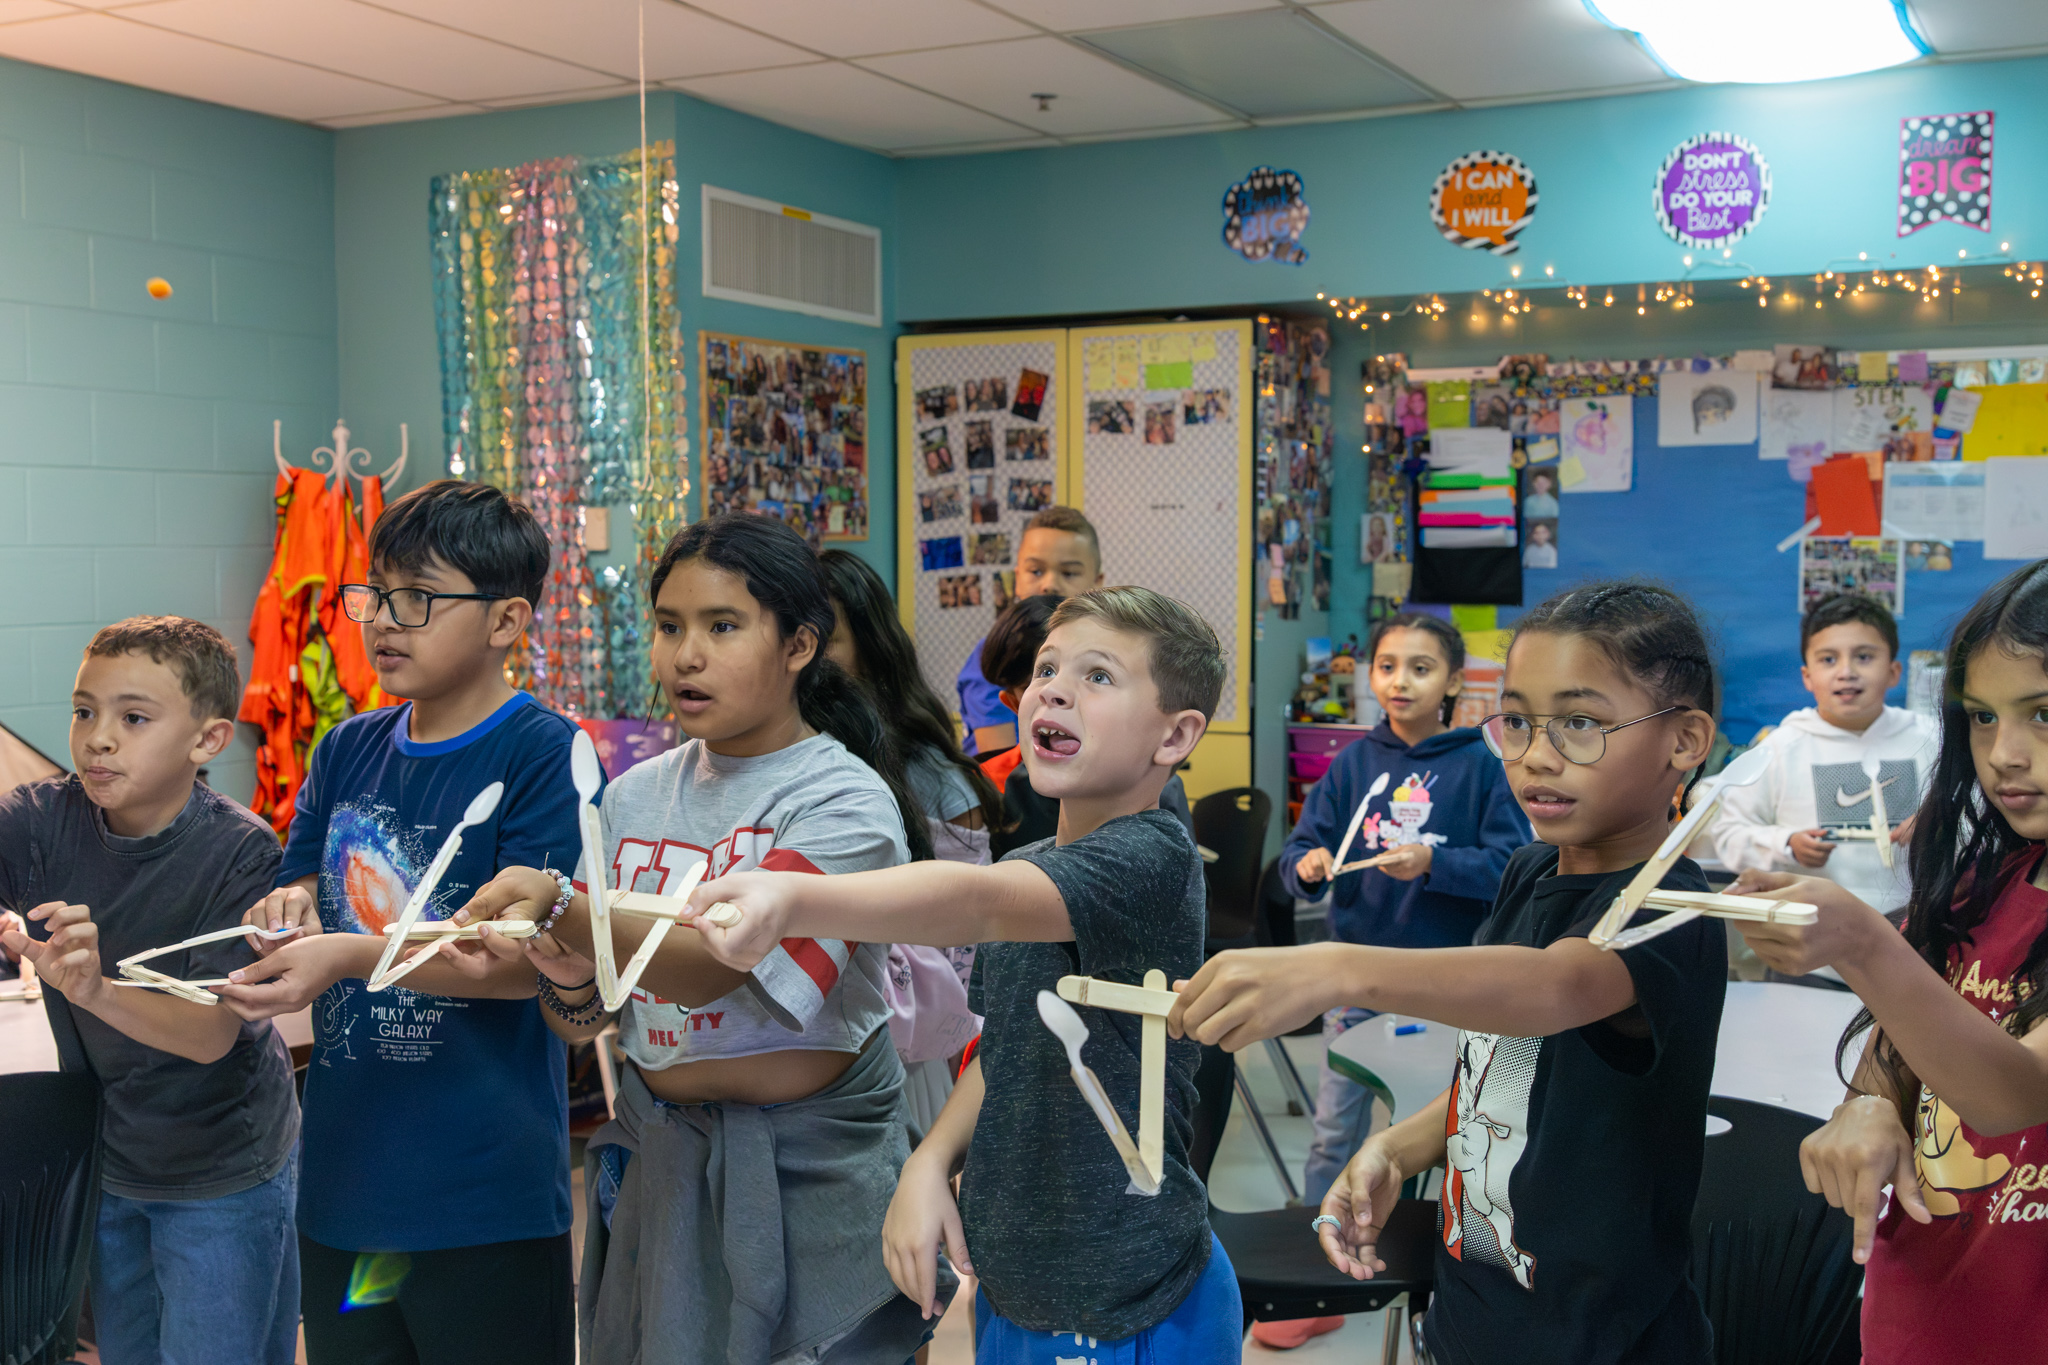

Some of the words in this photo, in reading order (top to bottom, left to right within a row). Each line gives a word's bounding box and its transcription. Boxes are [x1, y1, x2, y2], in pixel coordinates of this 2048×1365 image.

[1907, 135, 1983, 158] dream
[1684, 151, 1744, 171] DON'T
[1455, 171, 1463, 191] I
[1466, 170, 1514, 190] CAN
[1675, 170, 1750, 193] stress
[1909, 157, 1984, 197] BIG
[1463, 188, 1503, 206] and
[1669, 191, 1700, 210] DO
[1702, 189, 1754, 208] YOUR
[1241, 212, 1291, 243] BIG
[1452, 208, 1459, 227] I
[1463, 207, 1514, 227] WILL
[1687, 206, 1734, 232] Best
[398, 995, 416, 1007] THE
[371, 1006, 406, 1022] MILKY
[413, 1009, 444, 1023] WAY
[379, 1022, 433, 1039] GALAXY
